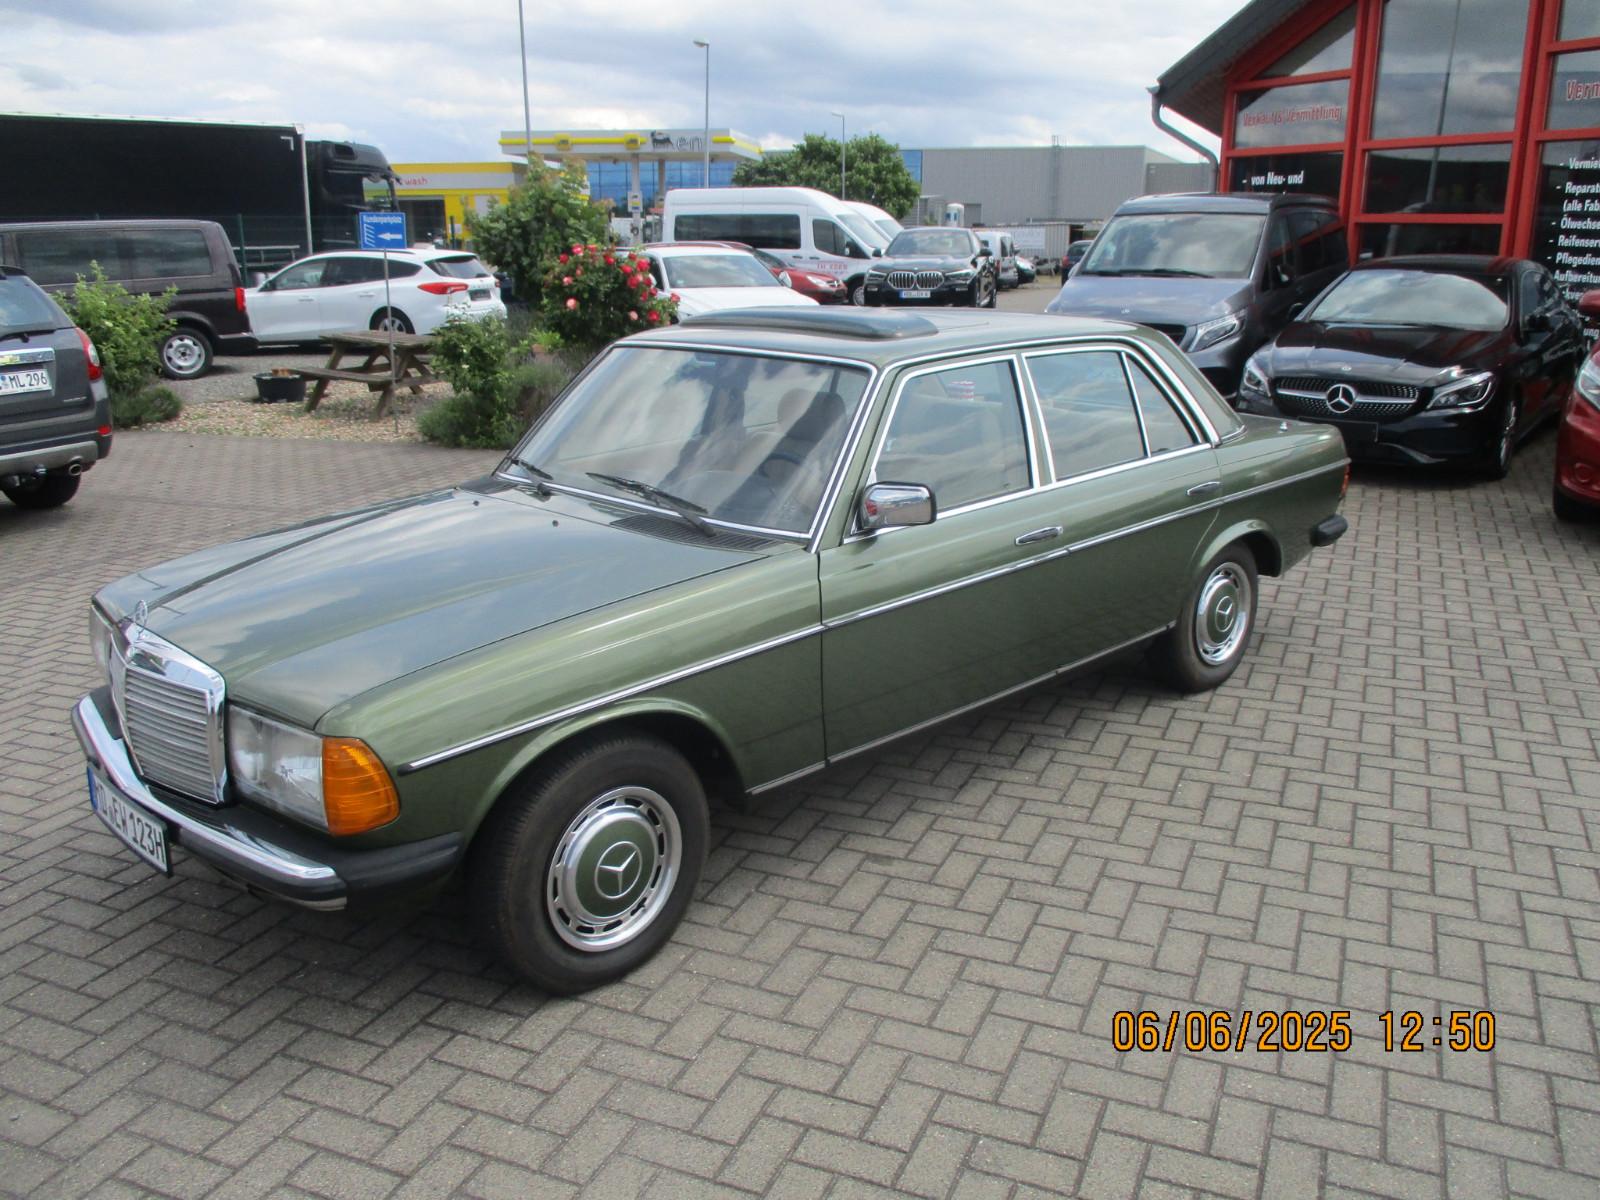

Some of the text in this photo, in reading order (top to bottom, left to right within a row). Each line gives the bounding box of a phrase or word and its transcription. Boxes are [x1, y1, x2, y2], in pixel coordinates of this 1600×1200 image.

[1251, 176, 1265, 186] von
[1287, 170, 1304, 184] und
[9, 373, 48, 389] ML 296
[129, 812, 165, 864] 123H
